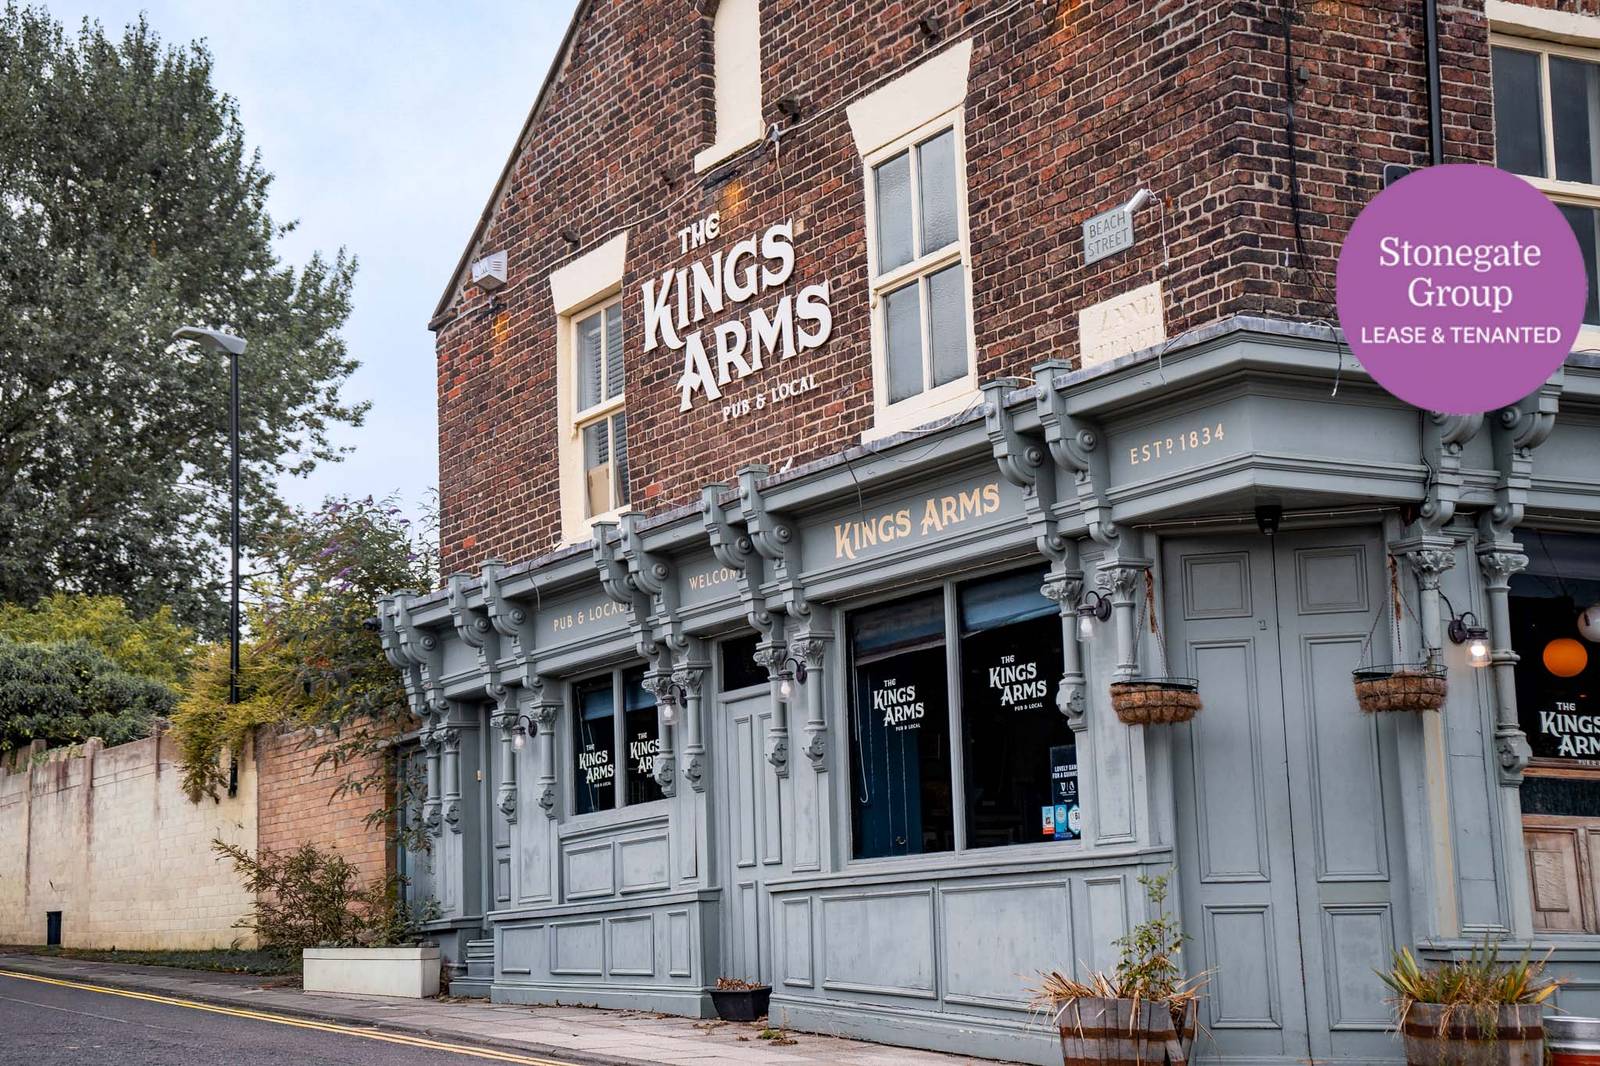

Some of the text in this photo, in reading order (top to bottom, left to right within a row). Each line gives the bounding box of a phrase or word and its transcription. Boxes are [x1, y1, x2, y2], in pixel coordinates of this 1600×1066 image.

[677, 211, 720, 254] THE
[1089, 210, 1126, 239] BEACH
[1087, 227, 1129, 257] STREET
[641, 218, 795, 353] KINGS
[676, 279, 833, 413] ARMS
[723, 374, 819, 422] PUB & LOCAL
[1180, 423, 1224, 451] 1834
[834, 482, 1000, 560] KINGS ARMS
[689, 567, 737, 590] WELCOM
[553, 615, 573, 632] PUB
[577, 611, 584, 625] &
[1001, 654, 1015, 664] THE
[883, 678, 896, 687] THE
[989, 662, 1037, 690] KINGS
[873, 685, 915, 711] KINGS
[1000, 680, 1047, 706] ARMS
[1555, 701, 1576, 711] THE
[883, 702, 925, 727] ARMS
[1539, 711, 1600, 737] KINGS
[630, 739, 660, 760] KINGS
[1558, 734, 1600, 757] ARM
[579, 750, 608, 770] KINGS
[638, 755, 655, 773] AR
[586, 764, 614, 784] ARMS
